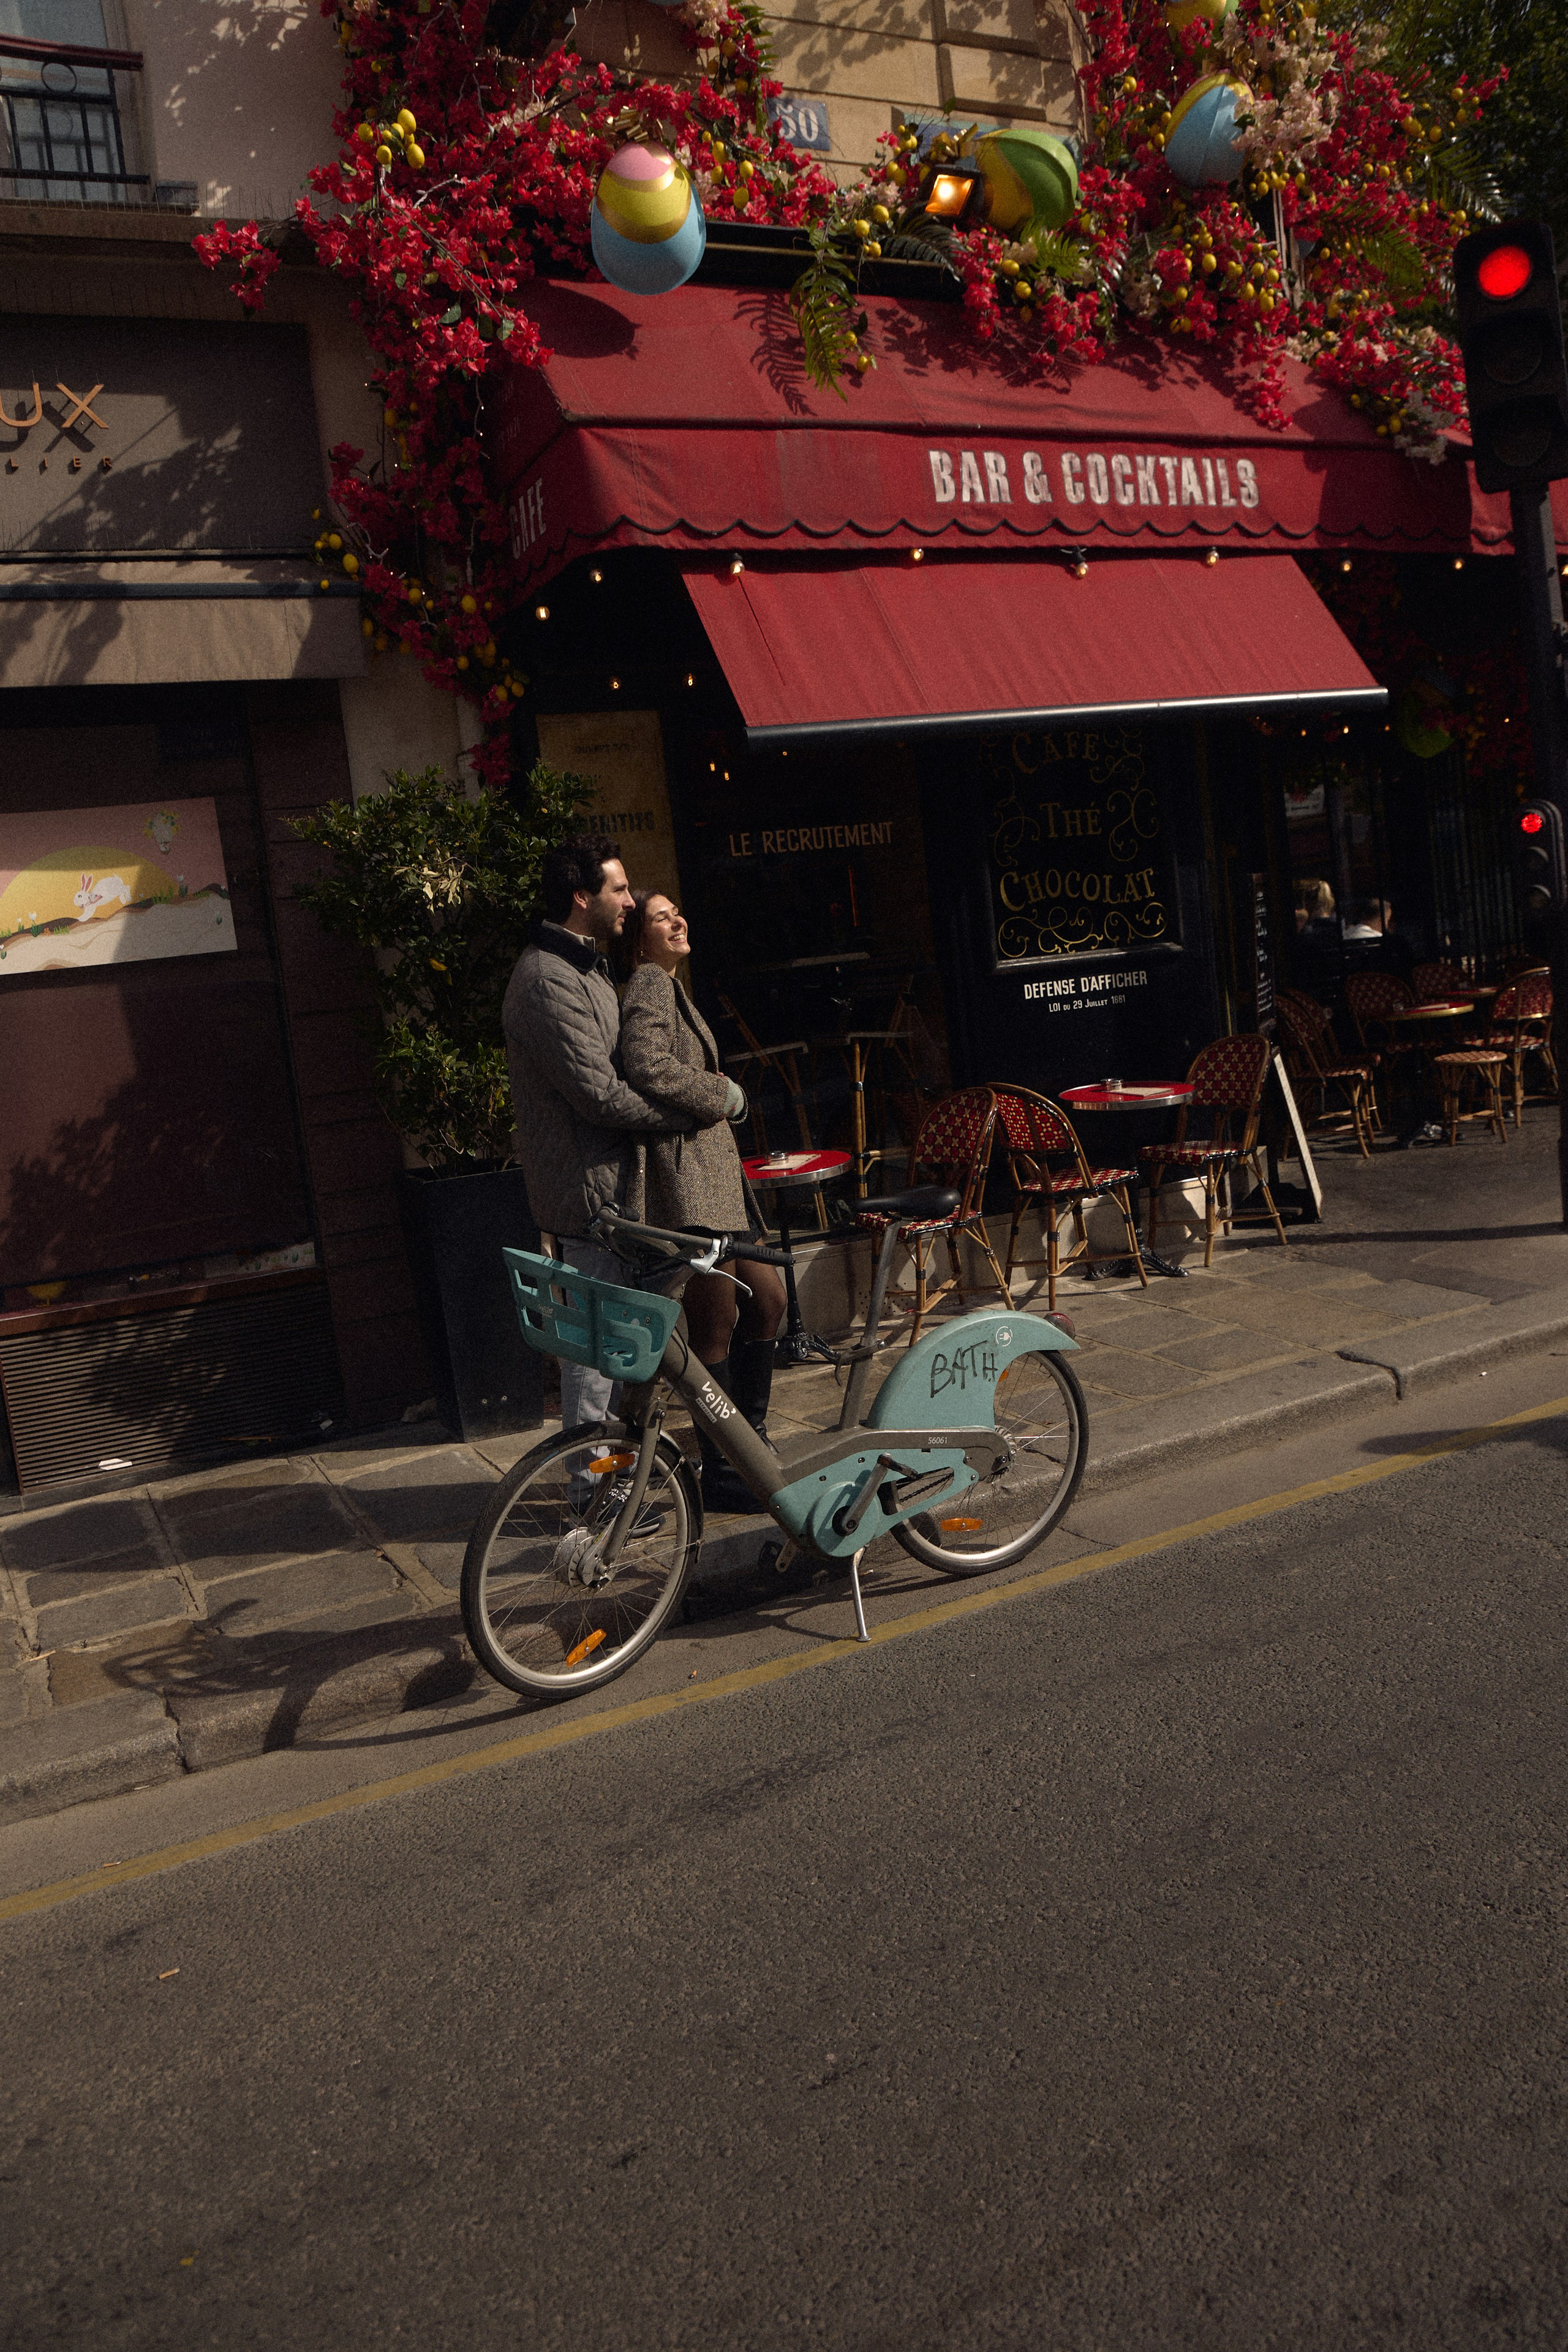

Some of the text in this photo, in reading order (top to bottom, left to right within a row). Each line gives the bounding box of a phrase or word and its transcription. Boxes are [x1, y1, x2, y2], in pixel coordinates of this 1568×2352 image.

[775, 103, 819, 141] 50
[929, 450, 1260, 508] BAR & COCKTAILS
[509, 477, 546, 560] CAFE
[729, 821, 893, 857] LE RECRUTEMENT
[1000, 867, 1155, 911] CHOCOLAT
[1023, 970, 1148, 1000] DEFENSE D'AFFICHER
[1049, 1002, 1061, 1012] LOI
[1073, 1000, 1083, 1009] 29
[1111, 994, 1126, 1004] 1881
